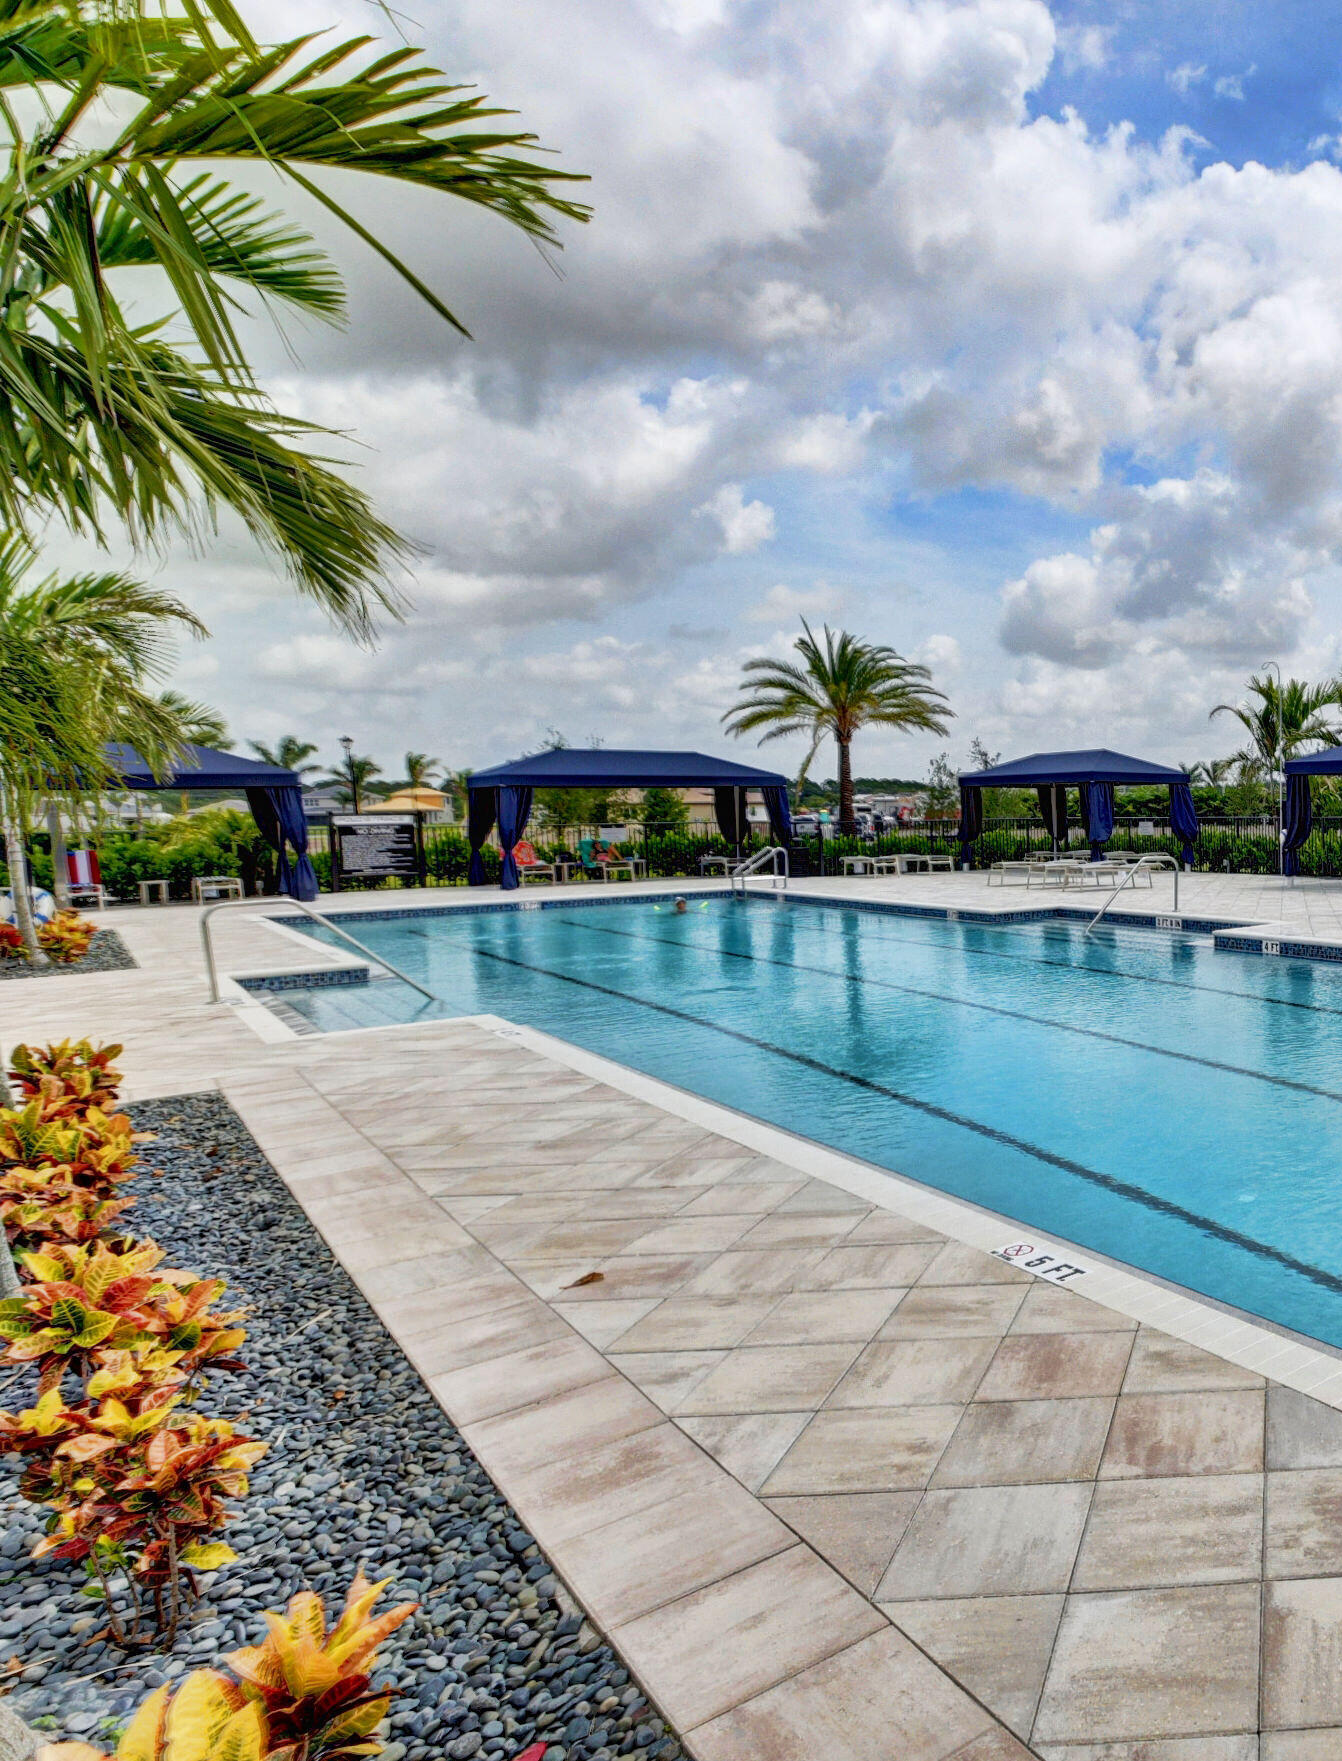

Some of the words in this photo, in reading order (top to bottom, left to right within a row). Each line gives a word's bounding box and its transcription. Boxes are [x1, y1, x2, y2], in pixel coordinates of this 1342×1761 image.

[1264, 941, 1269, 952] 4
[1271, 942, 1279, 953] FT
[1024, 1255, 1056, 1268] 5
[1041, 1263, 1087, 1282] FT
